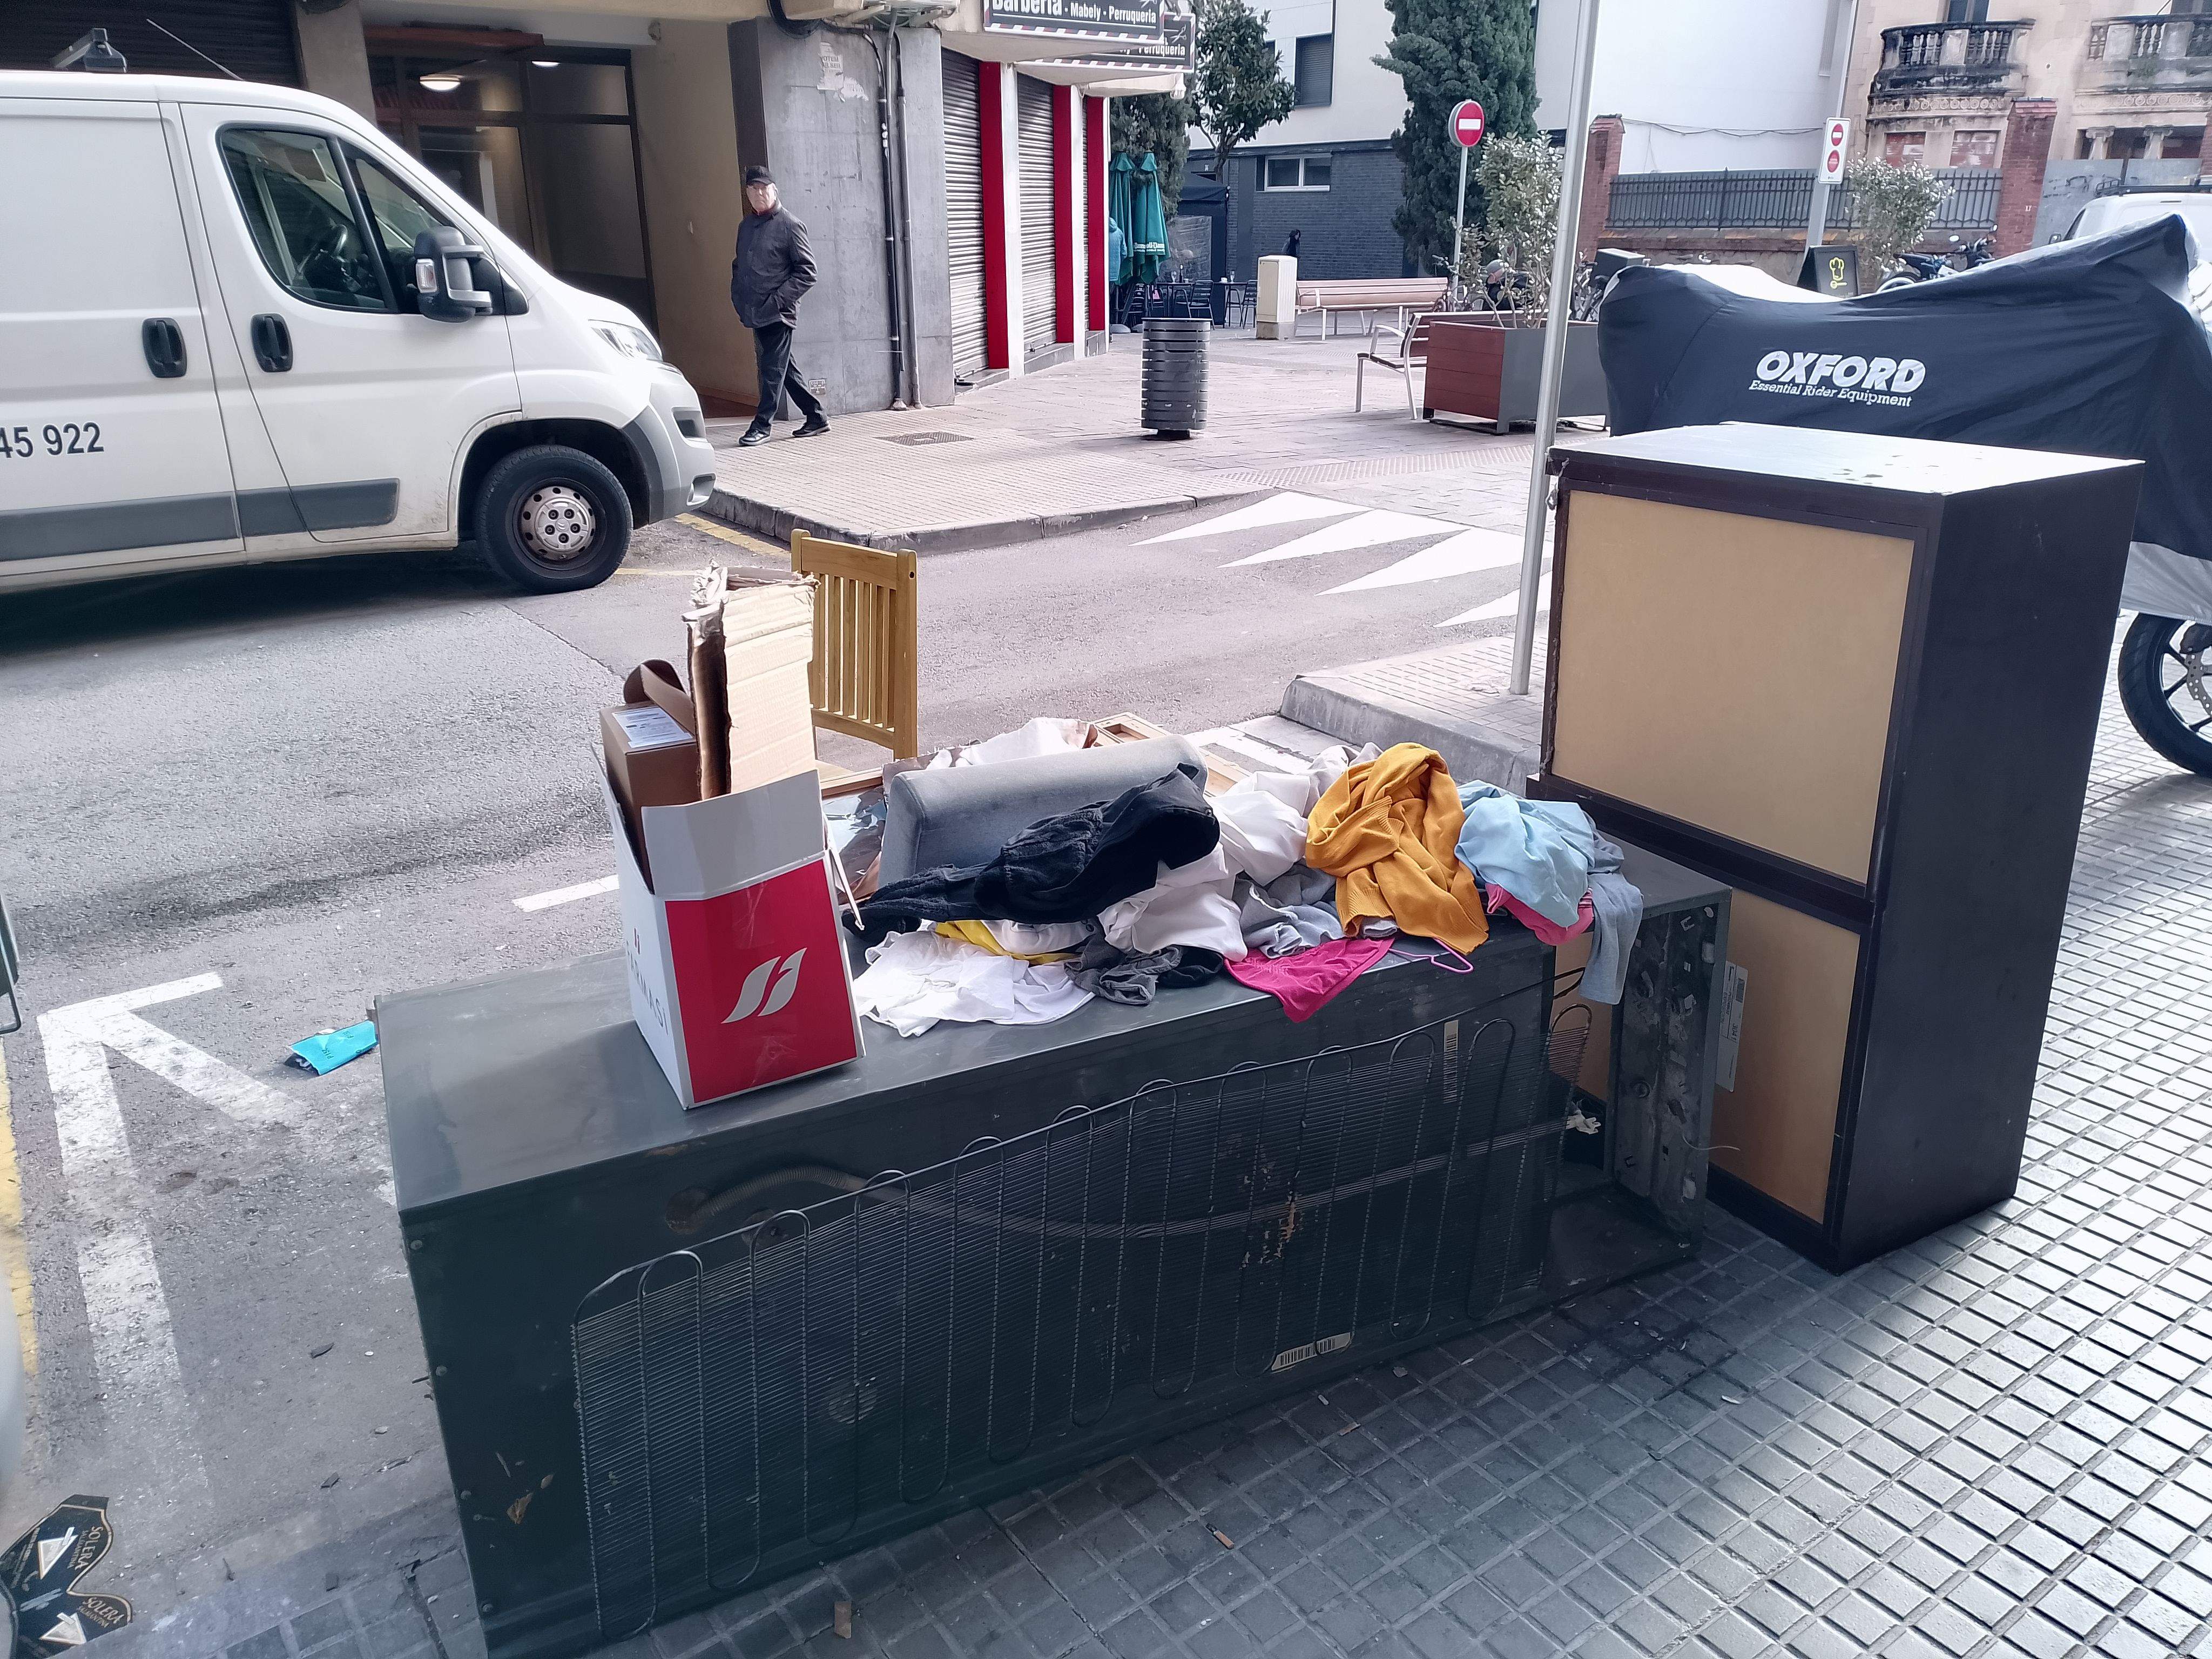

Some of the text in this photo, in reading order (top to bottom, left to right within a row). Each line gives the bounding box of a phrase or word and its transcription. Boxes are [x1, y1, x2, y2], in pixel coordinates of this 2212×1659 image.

[1070, 2, 1101, 22] Mabely
[1757, 350, 1926, 393] OXFORD
[1749, 380, 1912, 407] Essential Rider Equipment
[0, 422, 104, 458] 45 922
[75, 1526, 104, 1570] SOLERA
[82, 1597, 125, 1624] SOLERA
